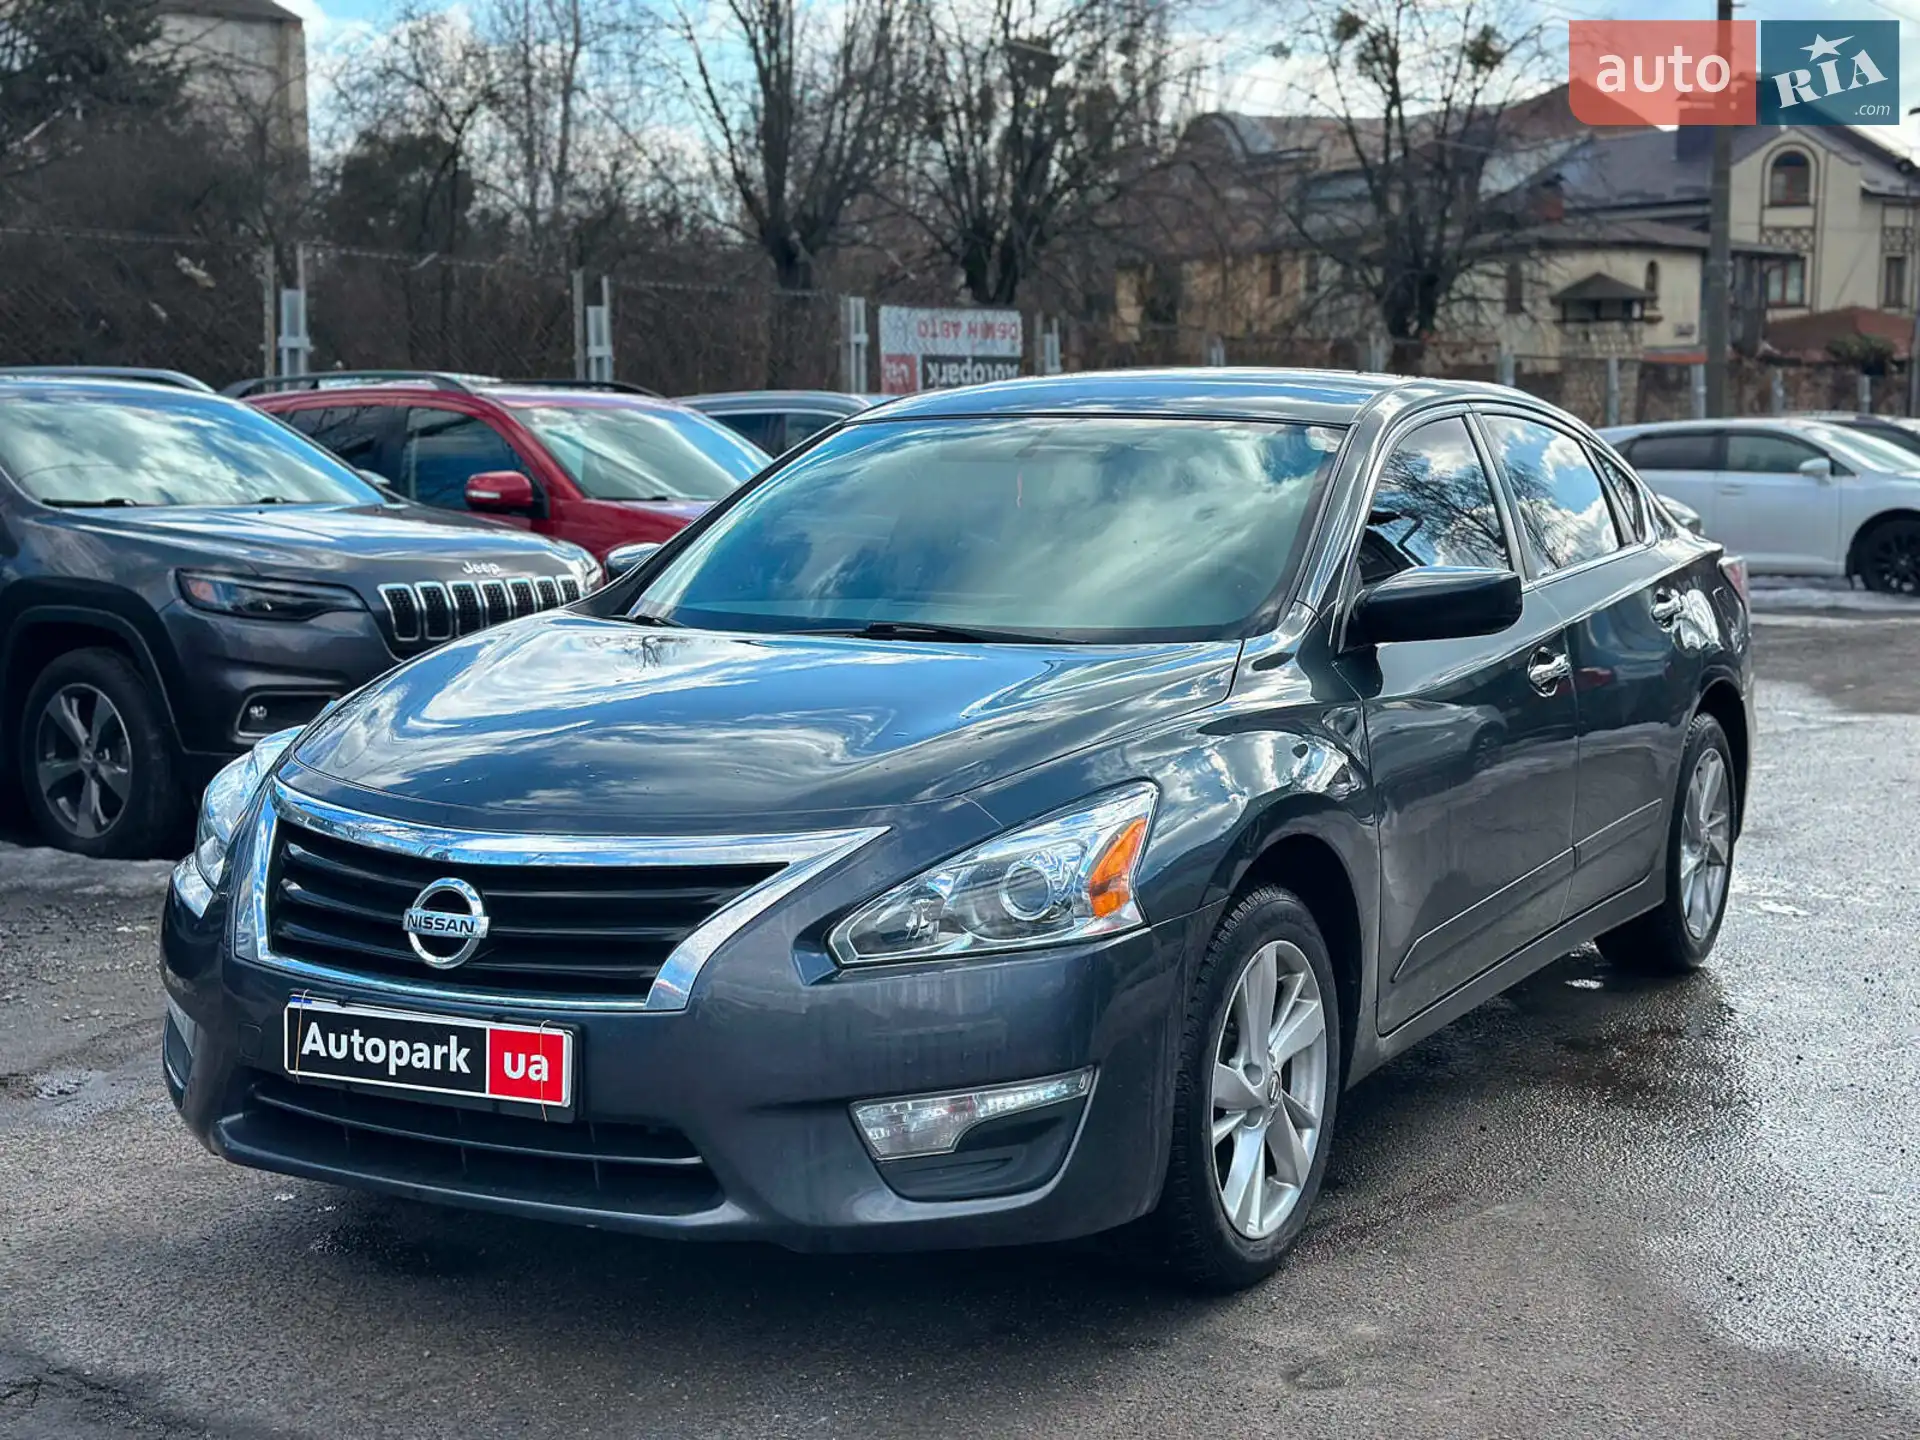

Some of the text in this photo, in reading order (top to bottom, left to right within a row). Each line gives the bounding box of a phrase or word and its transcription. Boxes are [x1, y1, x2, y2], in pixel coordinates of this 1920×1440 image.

[917, 319, 962, 339] АВТО
[462, 560, 500, 576] Jeep
[407, 914, 475, 933] NISSAN
[301, 1021, 549, 1082] Autopark ua
